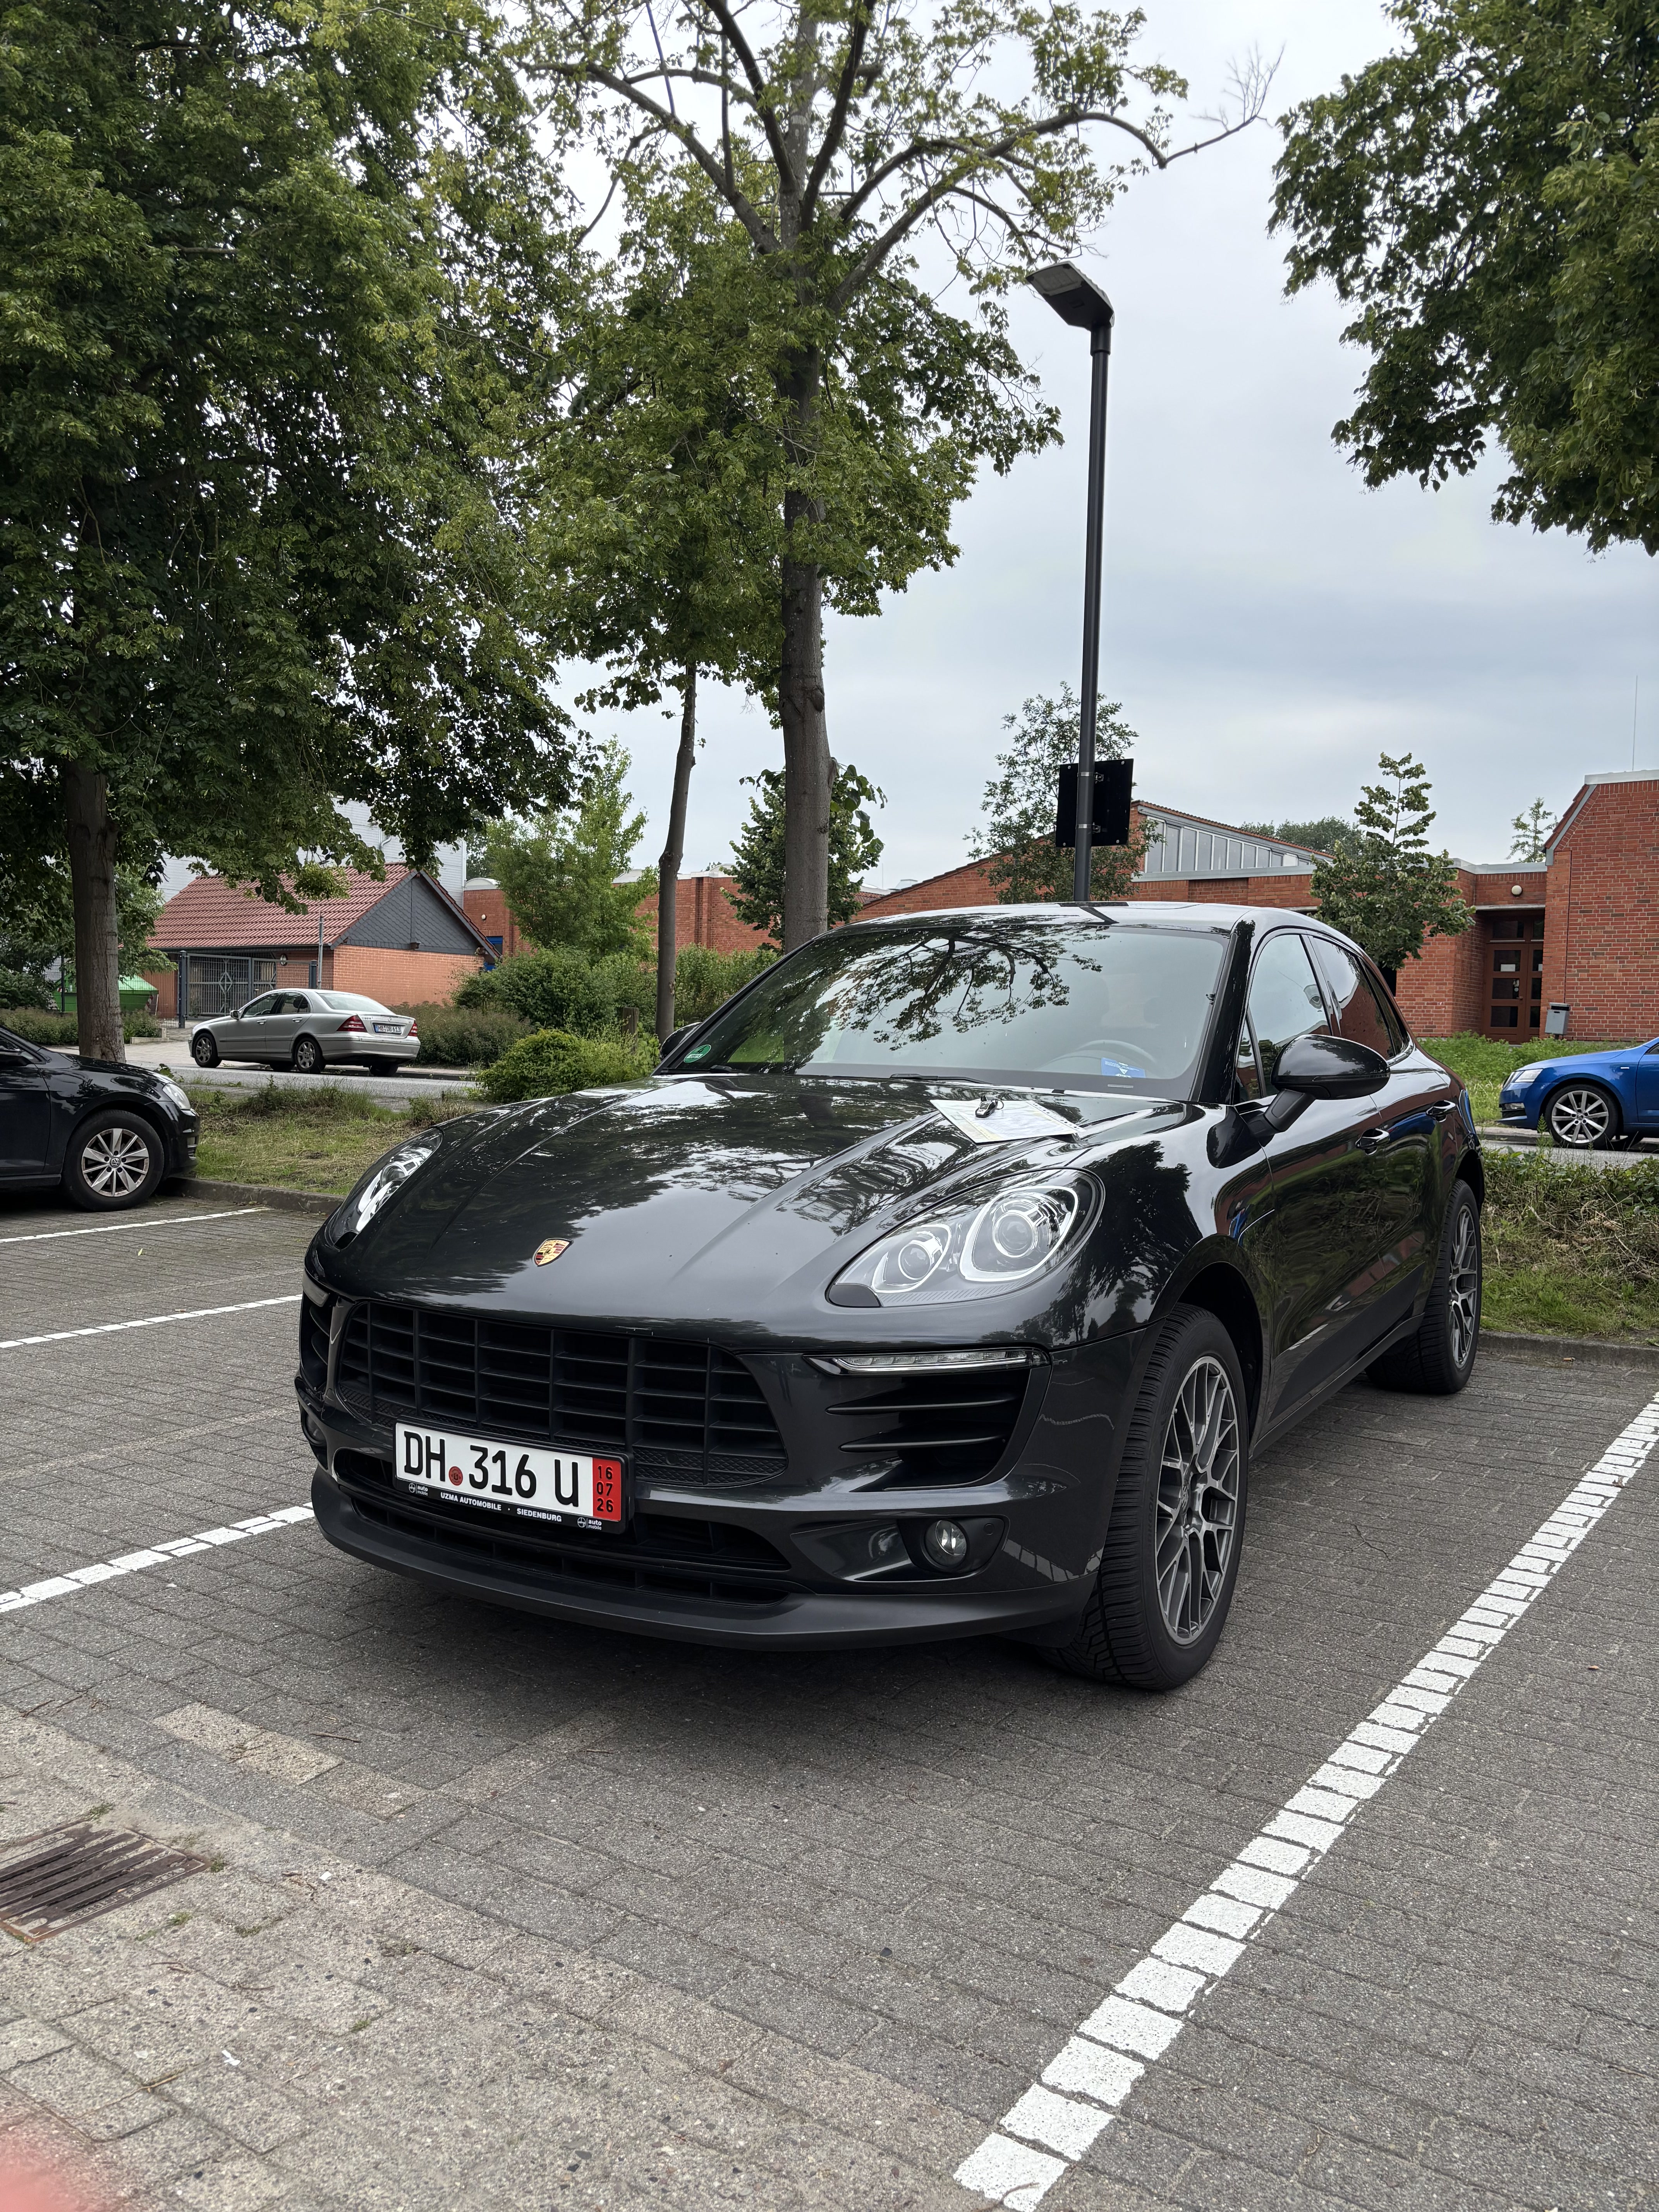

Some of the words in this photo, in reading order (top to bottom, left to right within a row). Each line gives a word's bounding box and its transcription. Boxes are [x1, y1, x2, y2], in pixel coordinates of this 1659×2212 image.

[404, 1431, 445, 1482] DH
[469, 1445, 537, 1499] 316
[554, 1459, 579, 1507] U
[598, 1466, 613, 1480] 16
[597, 1482, 613, 1496] 07
[441, 1492, 458, 1502] UZMA
[459, 1496, 501, 1511] AUTOMOBILE
[517, 1508, 562, 1522] SIEDENBURG
[597, 1498, 613, 1513] 26
